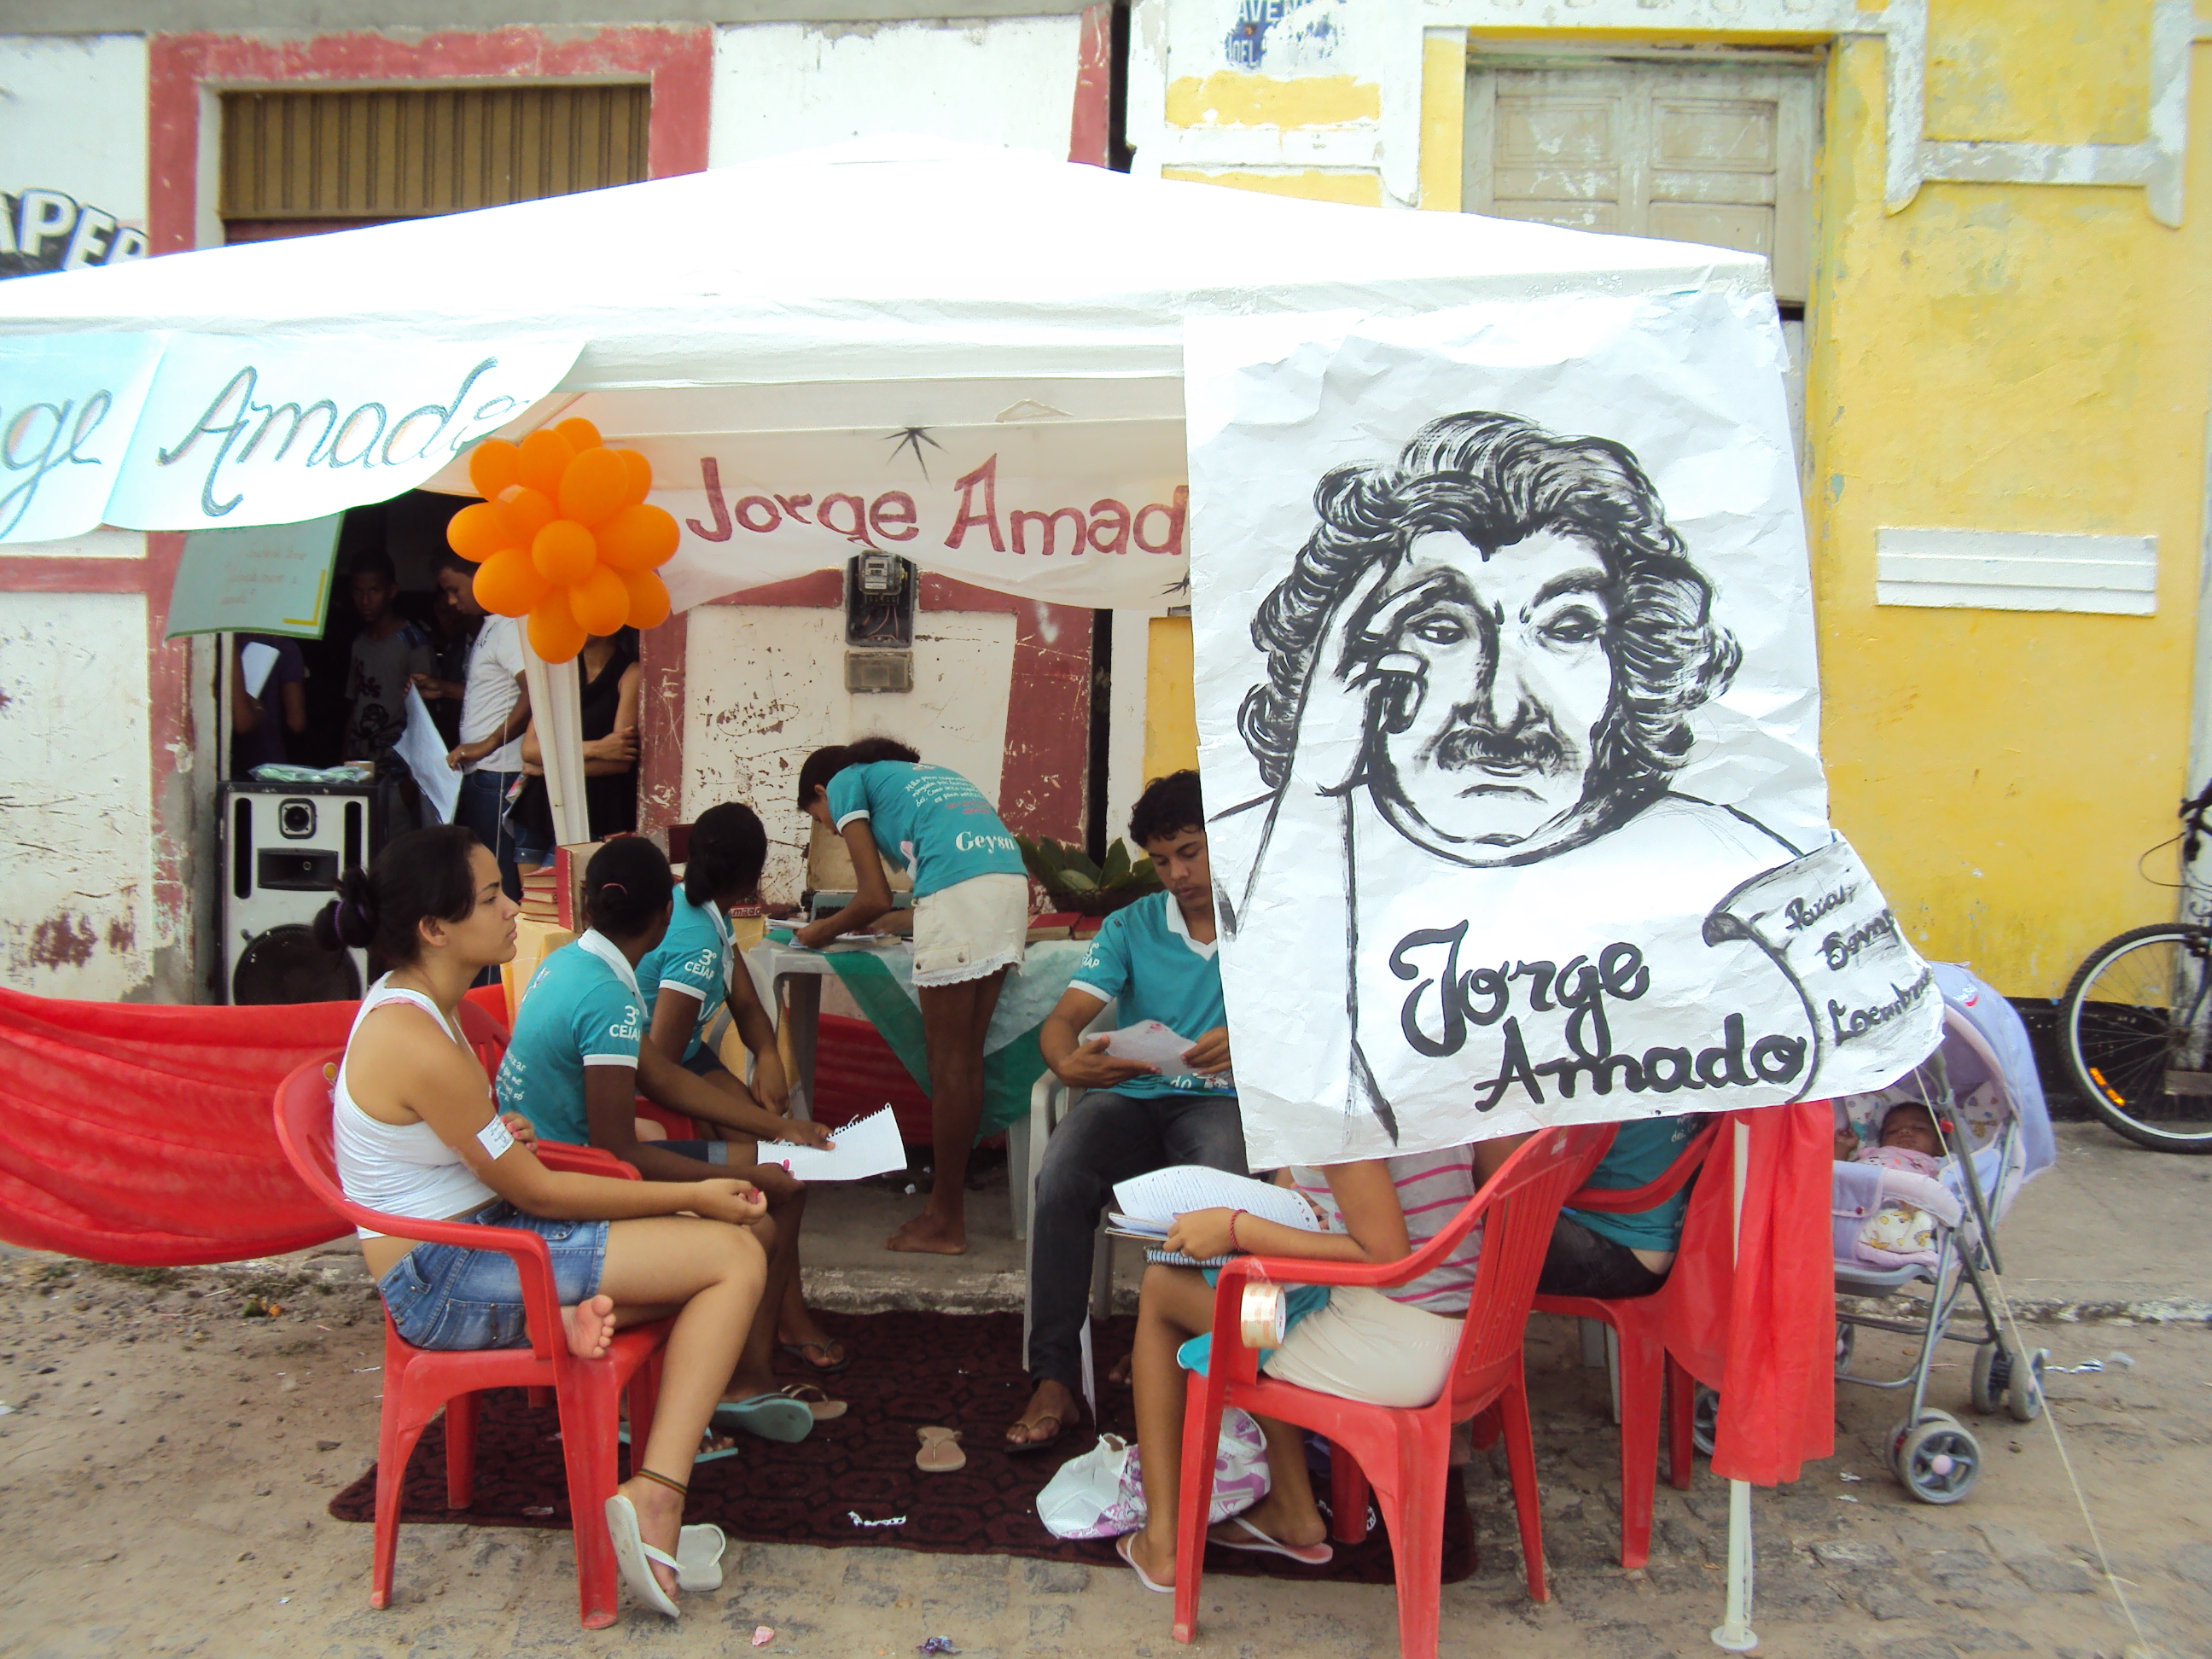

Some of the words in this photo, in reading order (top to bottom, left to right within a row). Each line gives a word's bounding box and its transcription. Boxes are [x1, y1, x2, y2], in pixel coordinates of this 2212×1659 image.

[1237, 0, 1302, 23] AVEN
[0, 389, 113, 539] ge
[155, 356, 530, 516] Amado
[685, 456, 919, 549] Jorge
[944, 453, 1189, 556] Amad
[955, 830, 1015, 853] Geysa
[1388, 919, 1650, 1061] Jorge
[1474, 1013, 1807, 1112] Amado
